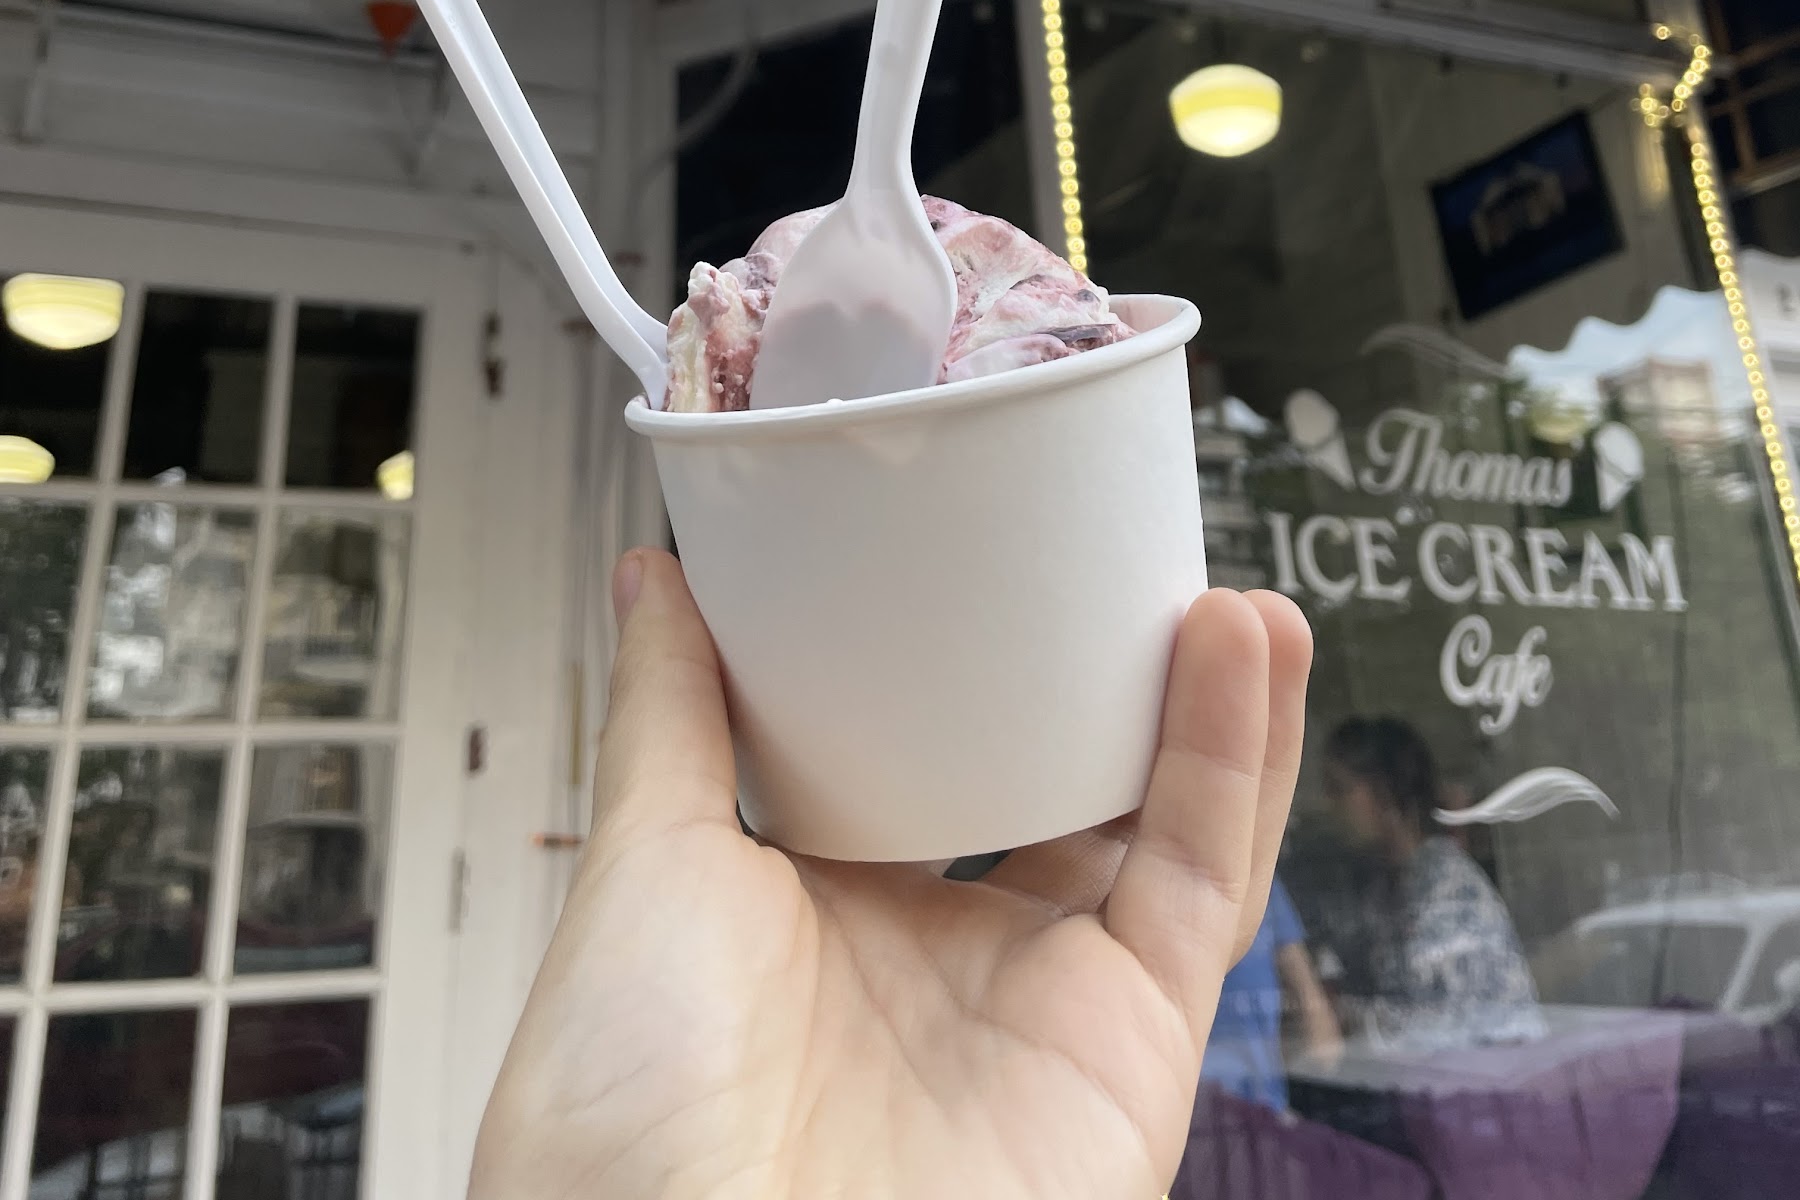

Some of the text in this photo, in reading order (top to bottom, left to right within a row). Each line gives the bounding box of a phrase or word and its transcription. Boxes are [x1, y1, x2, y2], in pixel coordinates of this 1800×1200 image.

[1359, 407, 1572, 507] Thomas
[1267, 511, 1688, 611] ICE CREAM
[1440, 613, 1553, 735] Cafe
